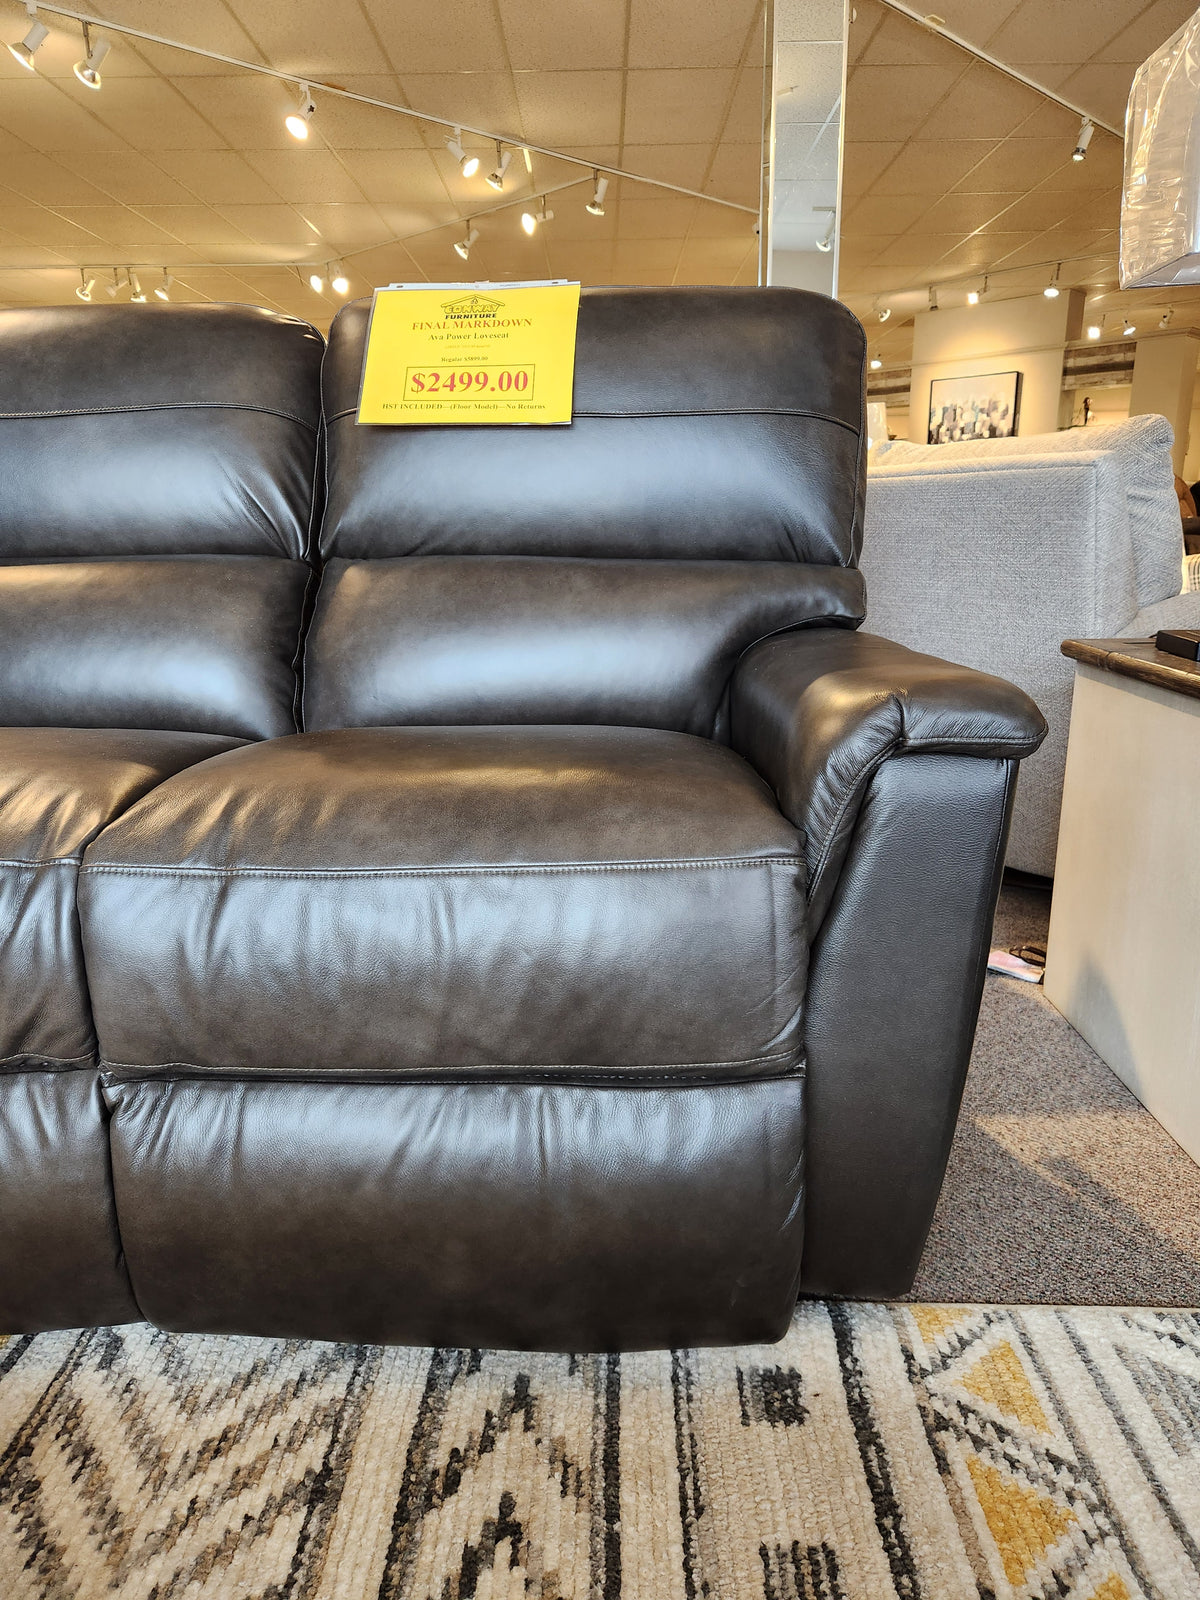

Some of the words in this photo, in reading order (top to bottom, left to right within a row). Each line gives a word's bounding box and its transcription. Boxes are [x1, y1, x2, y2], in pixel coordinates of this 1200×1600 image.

[444, 304, 499, 314] CONWAY
[412, 321, 450, 330] FINAL
[452, 318, 533, 329] MARKDOWN
[474, 332, 509, 340] Loveseat
[410, 370, 529, 394] $2499.00
